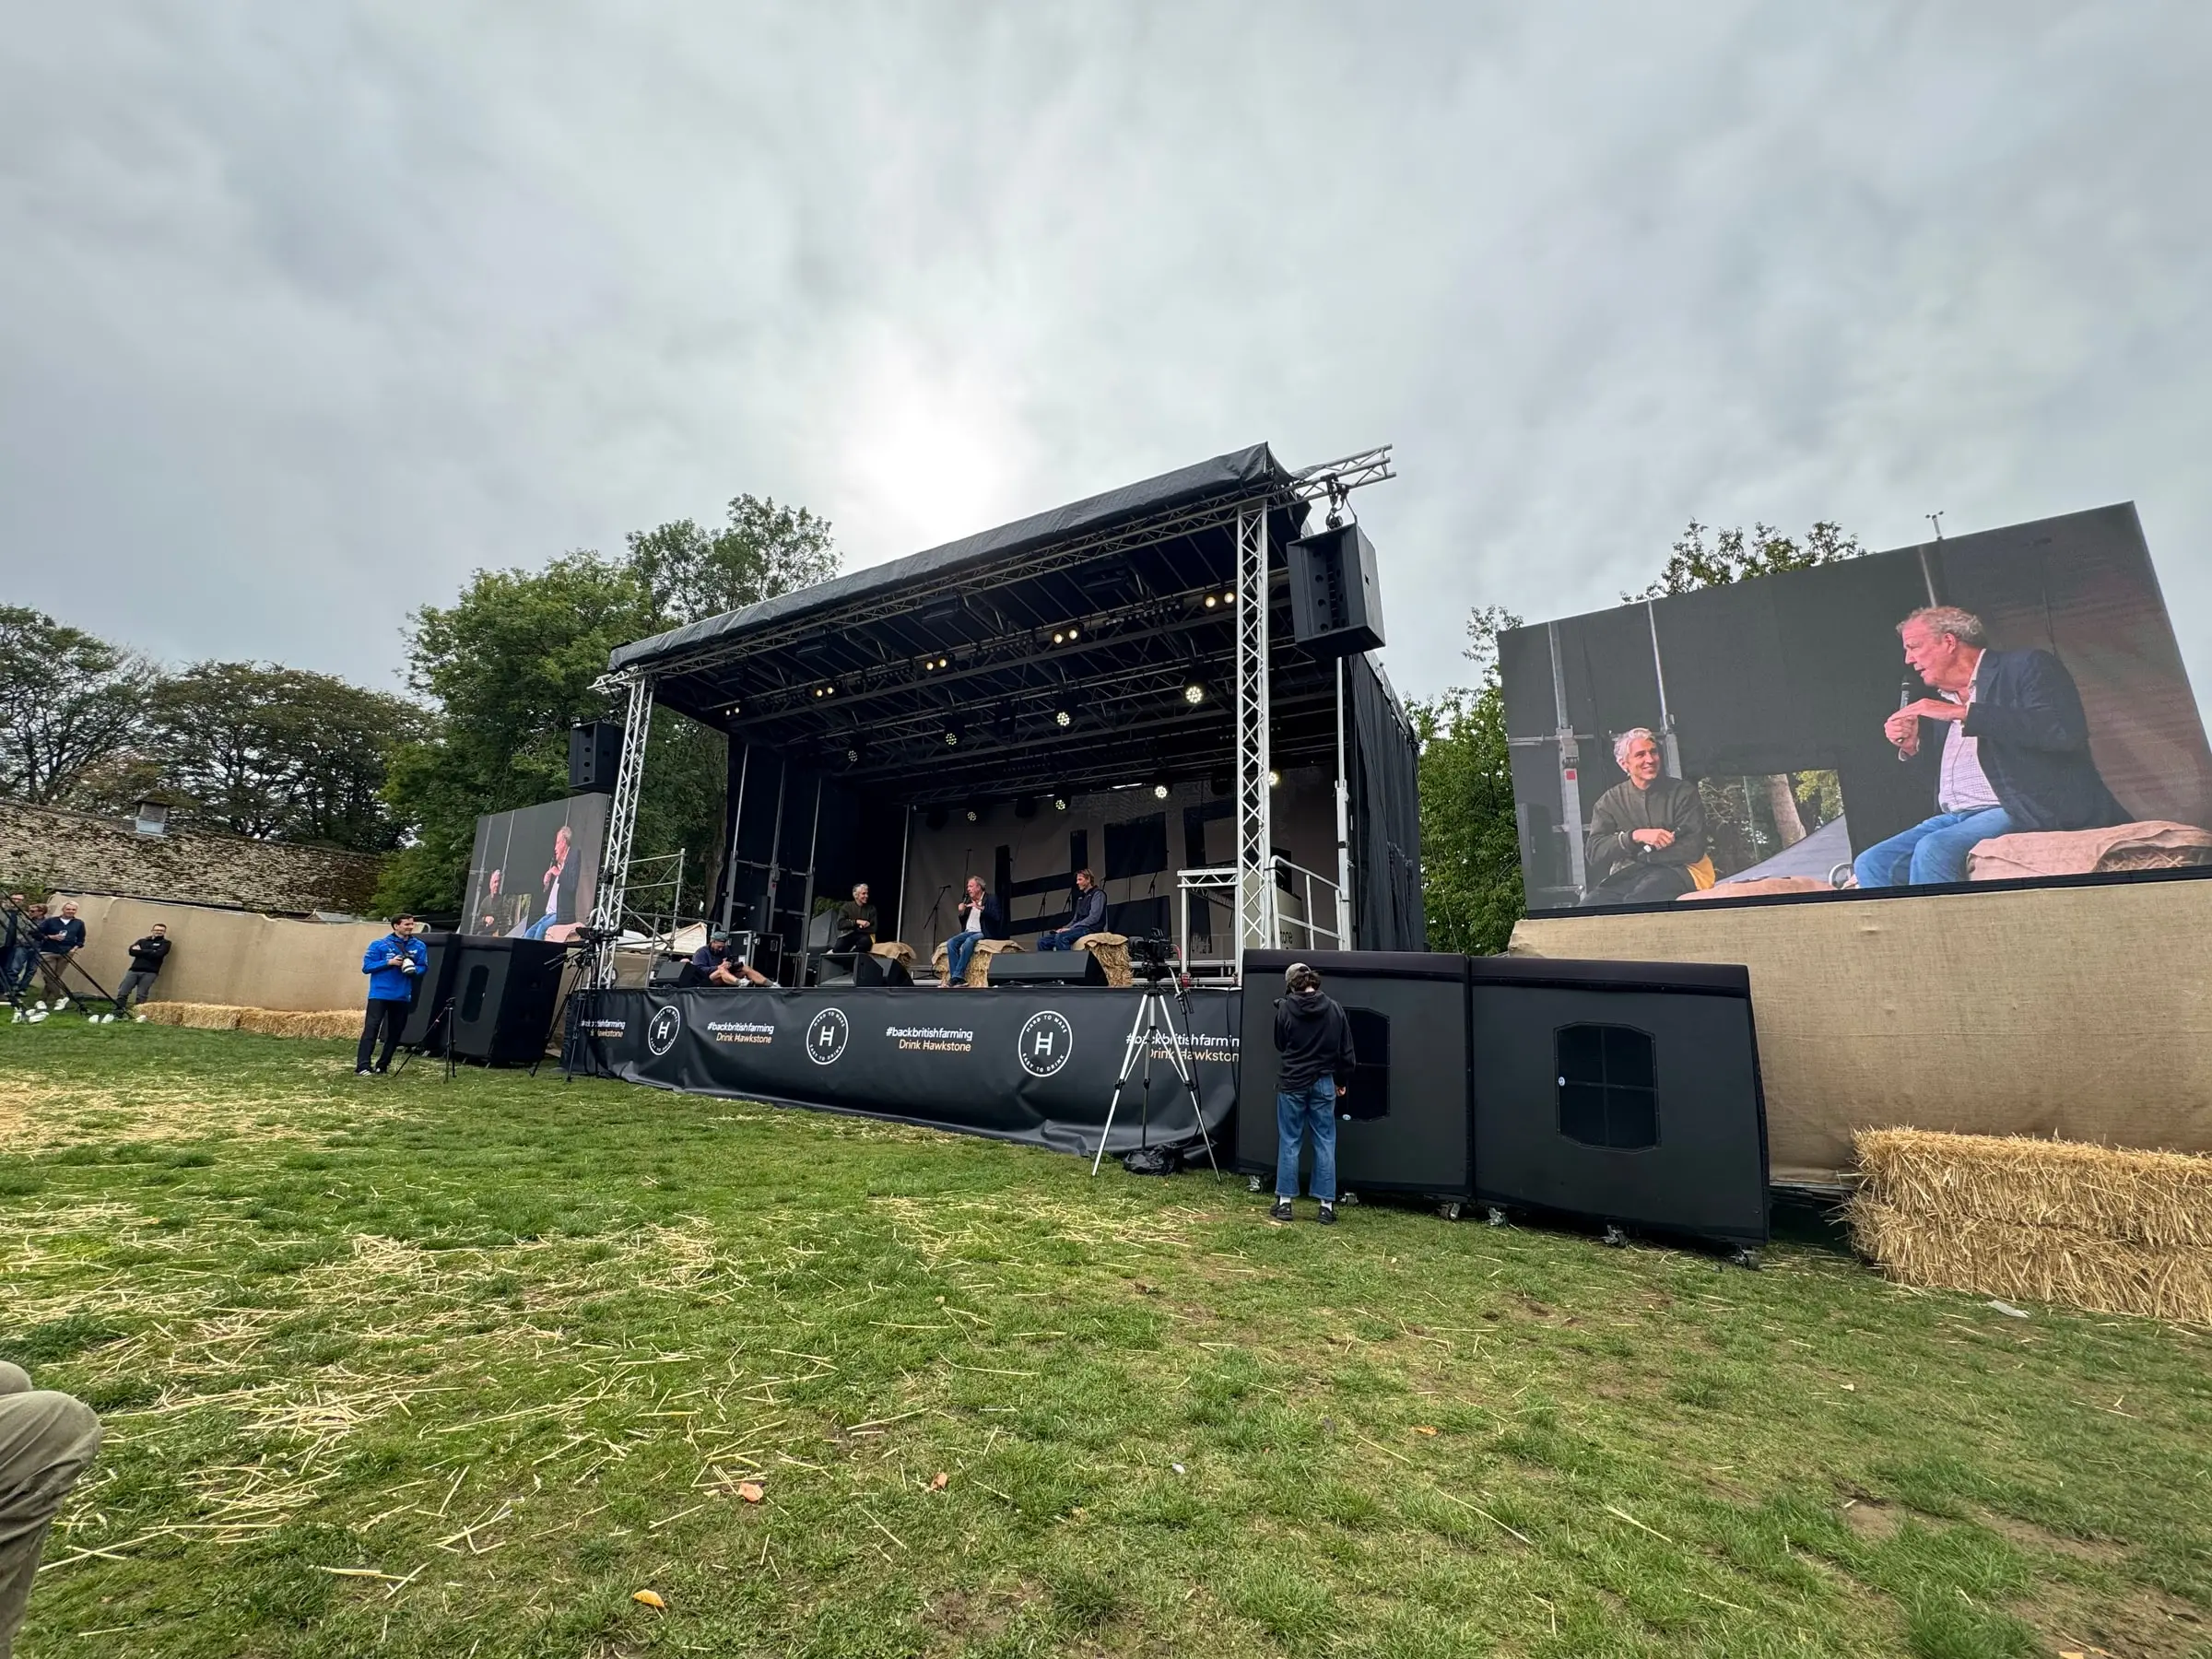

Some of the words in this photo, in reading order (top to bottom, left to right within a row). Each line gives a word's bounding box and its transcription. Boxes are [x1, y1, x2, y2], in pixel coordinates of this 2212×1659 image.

[657, 1021, 671, 1040] H
[707, 1021, 775, 1035] #backbritishfarming
[886, 1026, 973, 1041] #backbritishfarming
[1026, 1017, 1041, 1033] HARD
[1053, 1017, 1068, 1034] MAKE
[716, 1032, 733, 1041] Drink
[734, 1033, 772, 1044] Hawkstone
[818, 1025, 835, 1047] H
[1034, 1031, 1053, 1056] H
[899, 1039, 921, 1050] Drink
[923, 1040, 971, 1052] Hawkstone
[1022, 1053, 1034, 1069] EASY
[1046, 1053, 1065, 1072] DRINK
